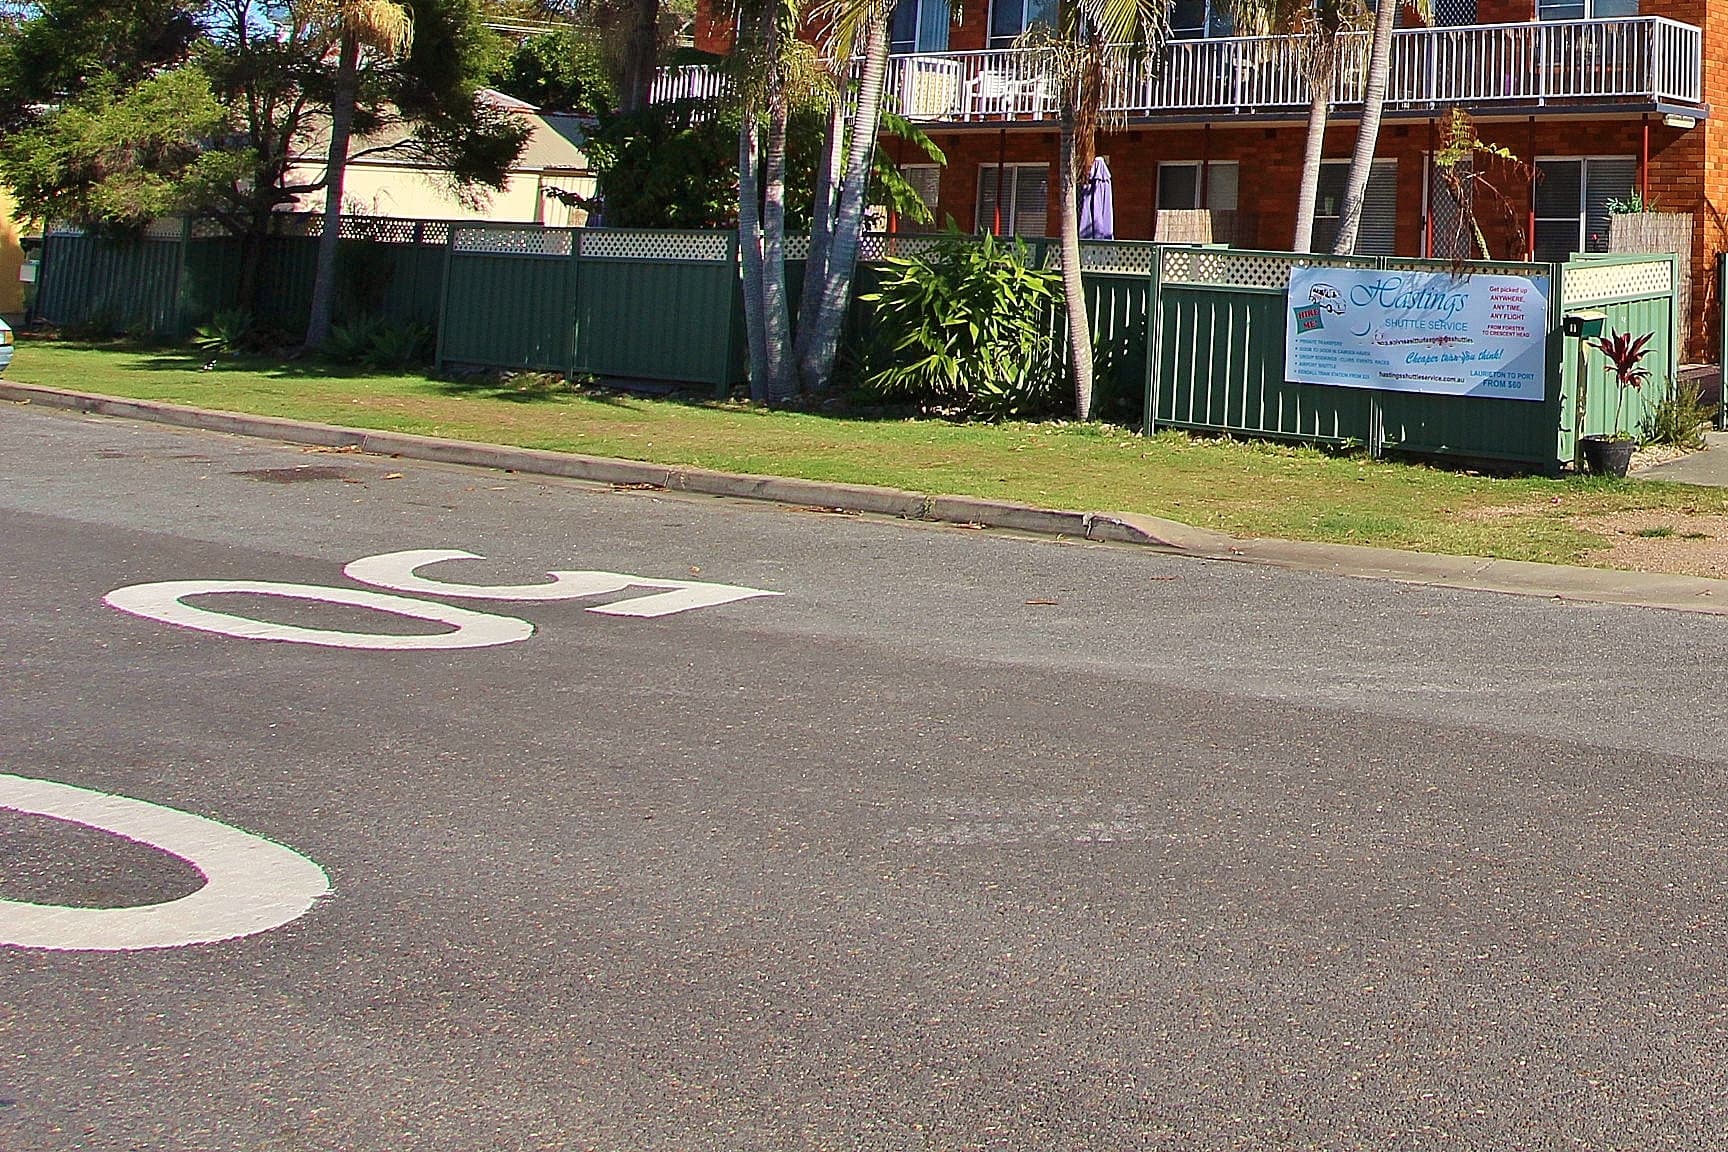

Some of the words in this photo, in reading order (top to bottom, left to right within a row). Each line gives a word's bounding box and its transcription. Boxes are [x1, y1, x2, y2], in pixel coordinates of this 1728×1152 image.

[1500, 286, 1520, 294] picked
[1350, 277, 1469, 320] Hastings
[1298, 309, 1320, 319] HIRE
[1503, 313, 1525, 321] FLIGHT
[1385, 318, 1425, 329] SHUTTLE
[1428, 320, 1468, 332] SERVICE
[1405, 351, 1439, 365] Cheaper
[1478, 348, 1504, 361] think!
[1483, 379, 1506, 388] FROM
